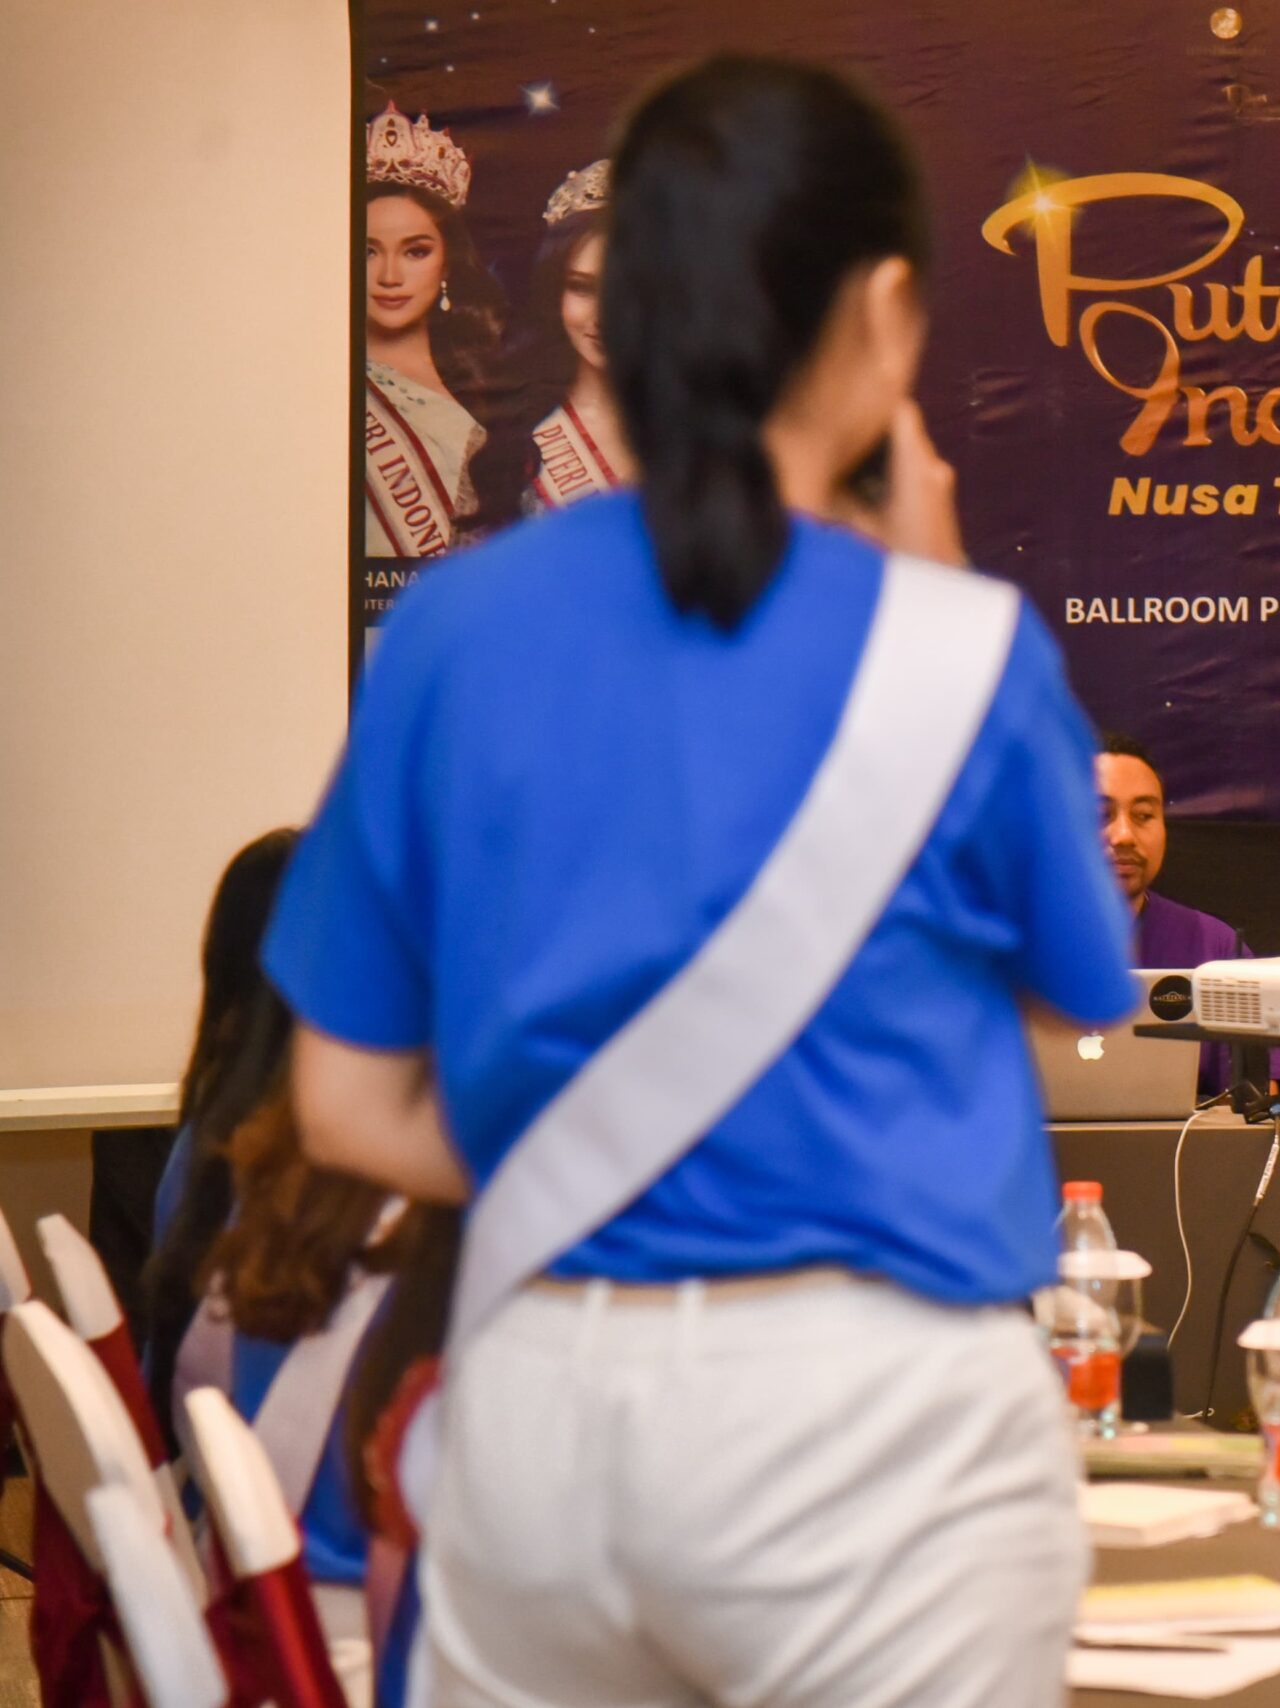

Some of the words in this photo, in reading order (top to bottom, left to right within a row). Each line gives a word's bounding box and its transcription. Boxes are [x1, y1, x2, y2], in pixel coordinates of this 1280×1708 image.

[531, 423, 594, 497] PUTERI
[1108, 476, 1259, 517] Nusa
[1065, 596, 1249, 624] BALLROOM
